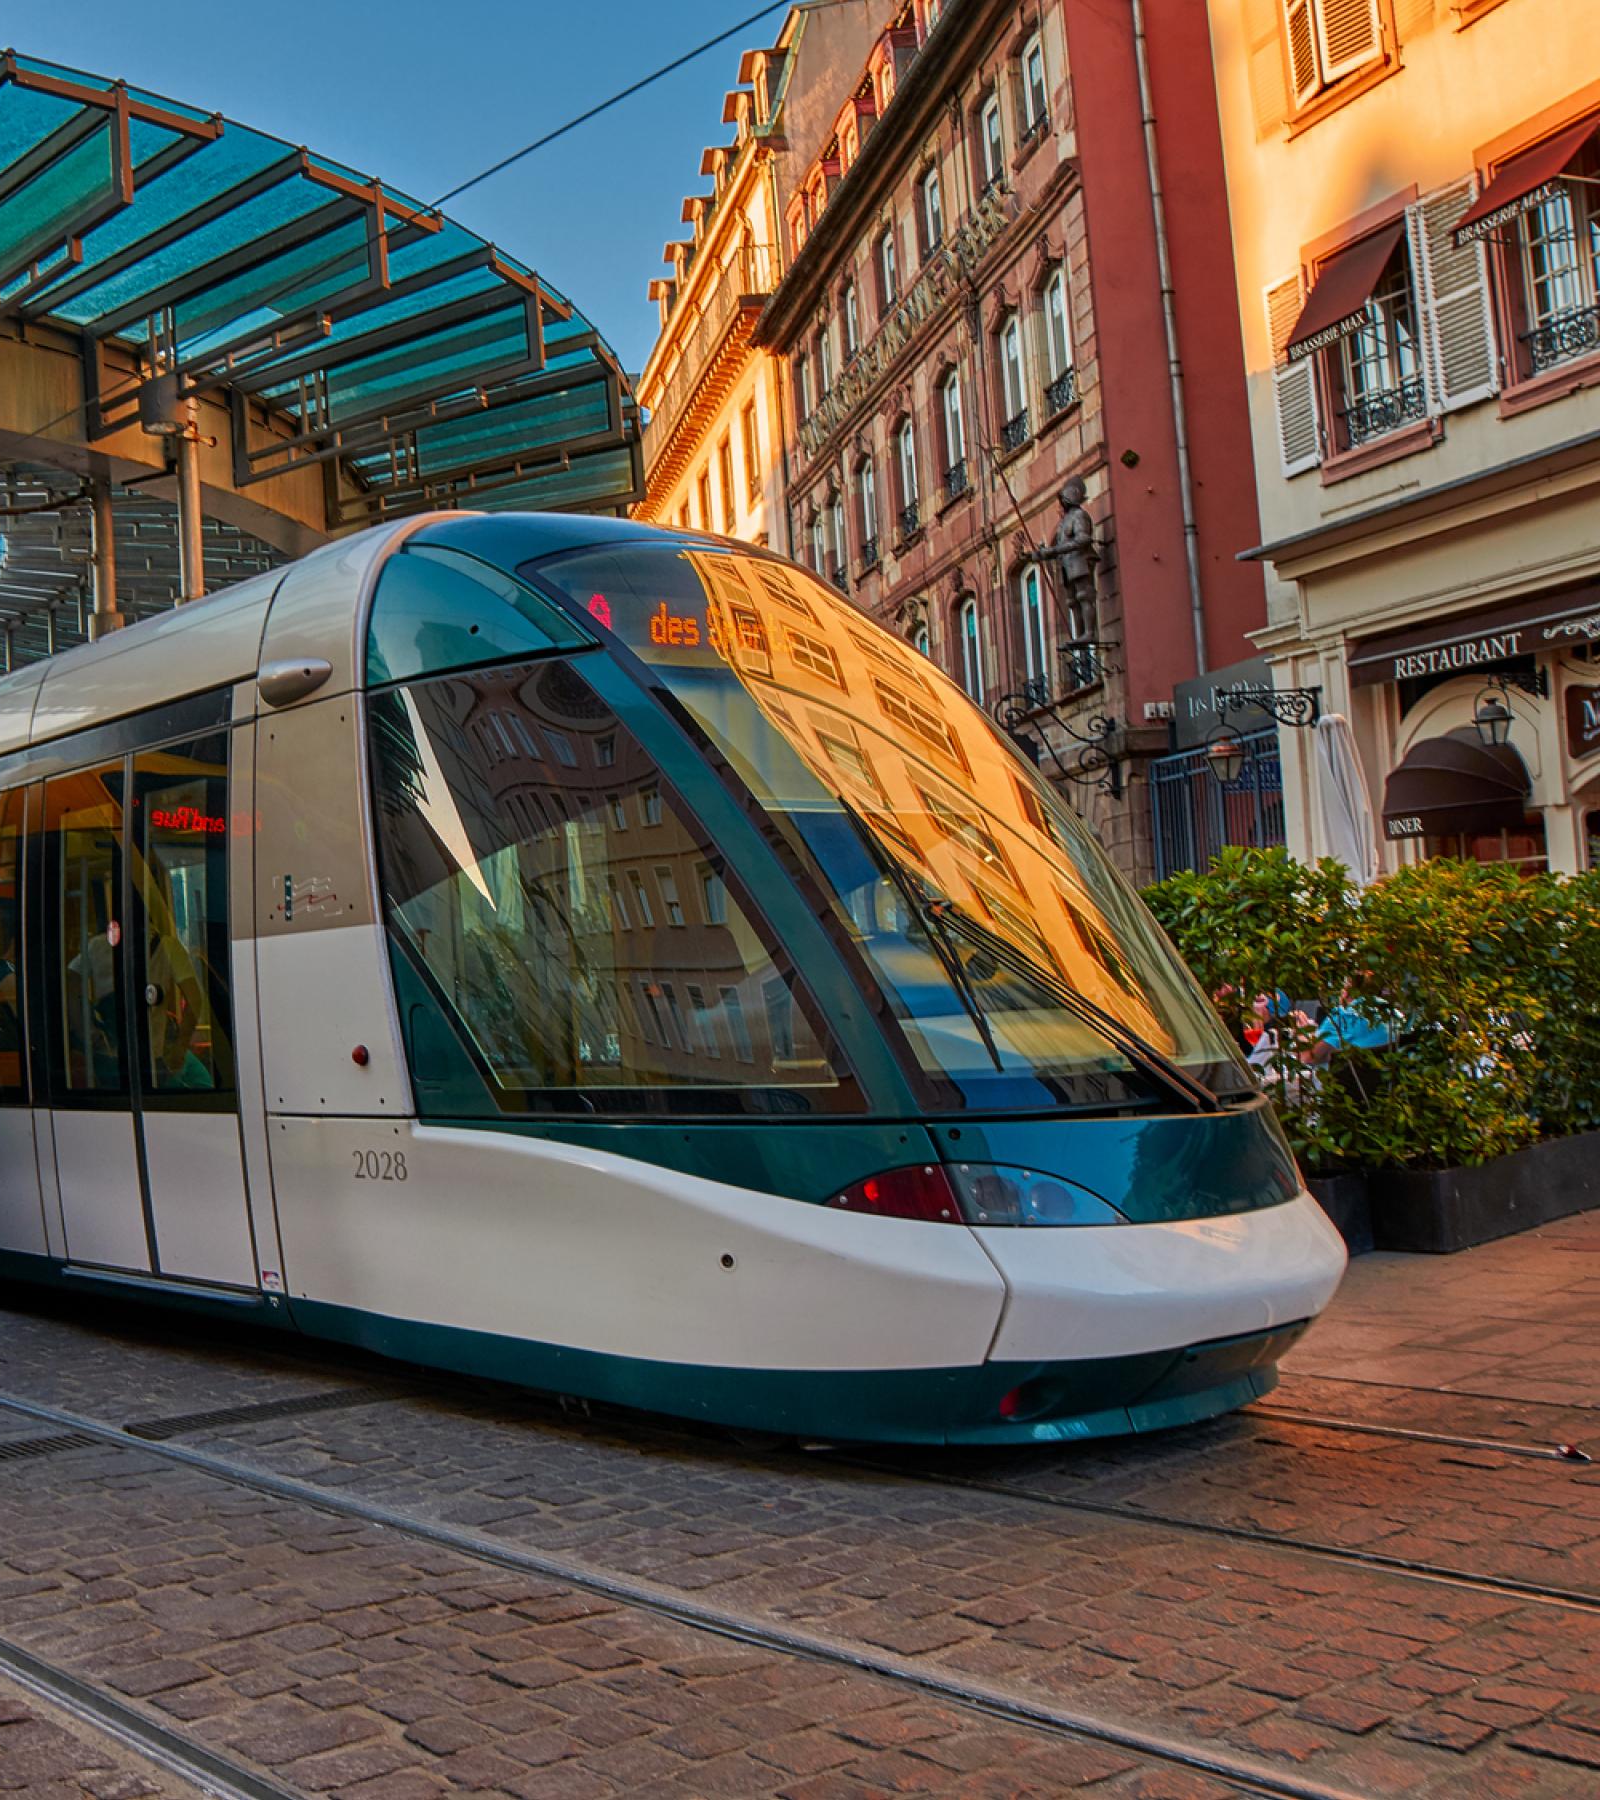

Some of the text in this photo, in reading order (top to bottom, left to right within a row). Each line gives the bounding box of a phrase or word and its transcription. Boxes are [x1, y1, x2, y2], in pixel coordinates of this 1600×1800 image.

[1458, 201, 1519, 245] BRASSERIE
[1289, 311, 1365, 360] BRASSERIE MAX
[650, 602, 700, 646] des
[1395, 632, 1521, 679] RESTAURANT
[352, 1150, 408, 1181] 2028
